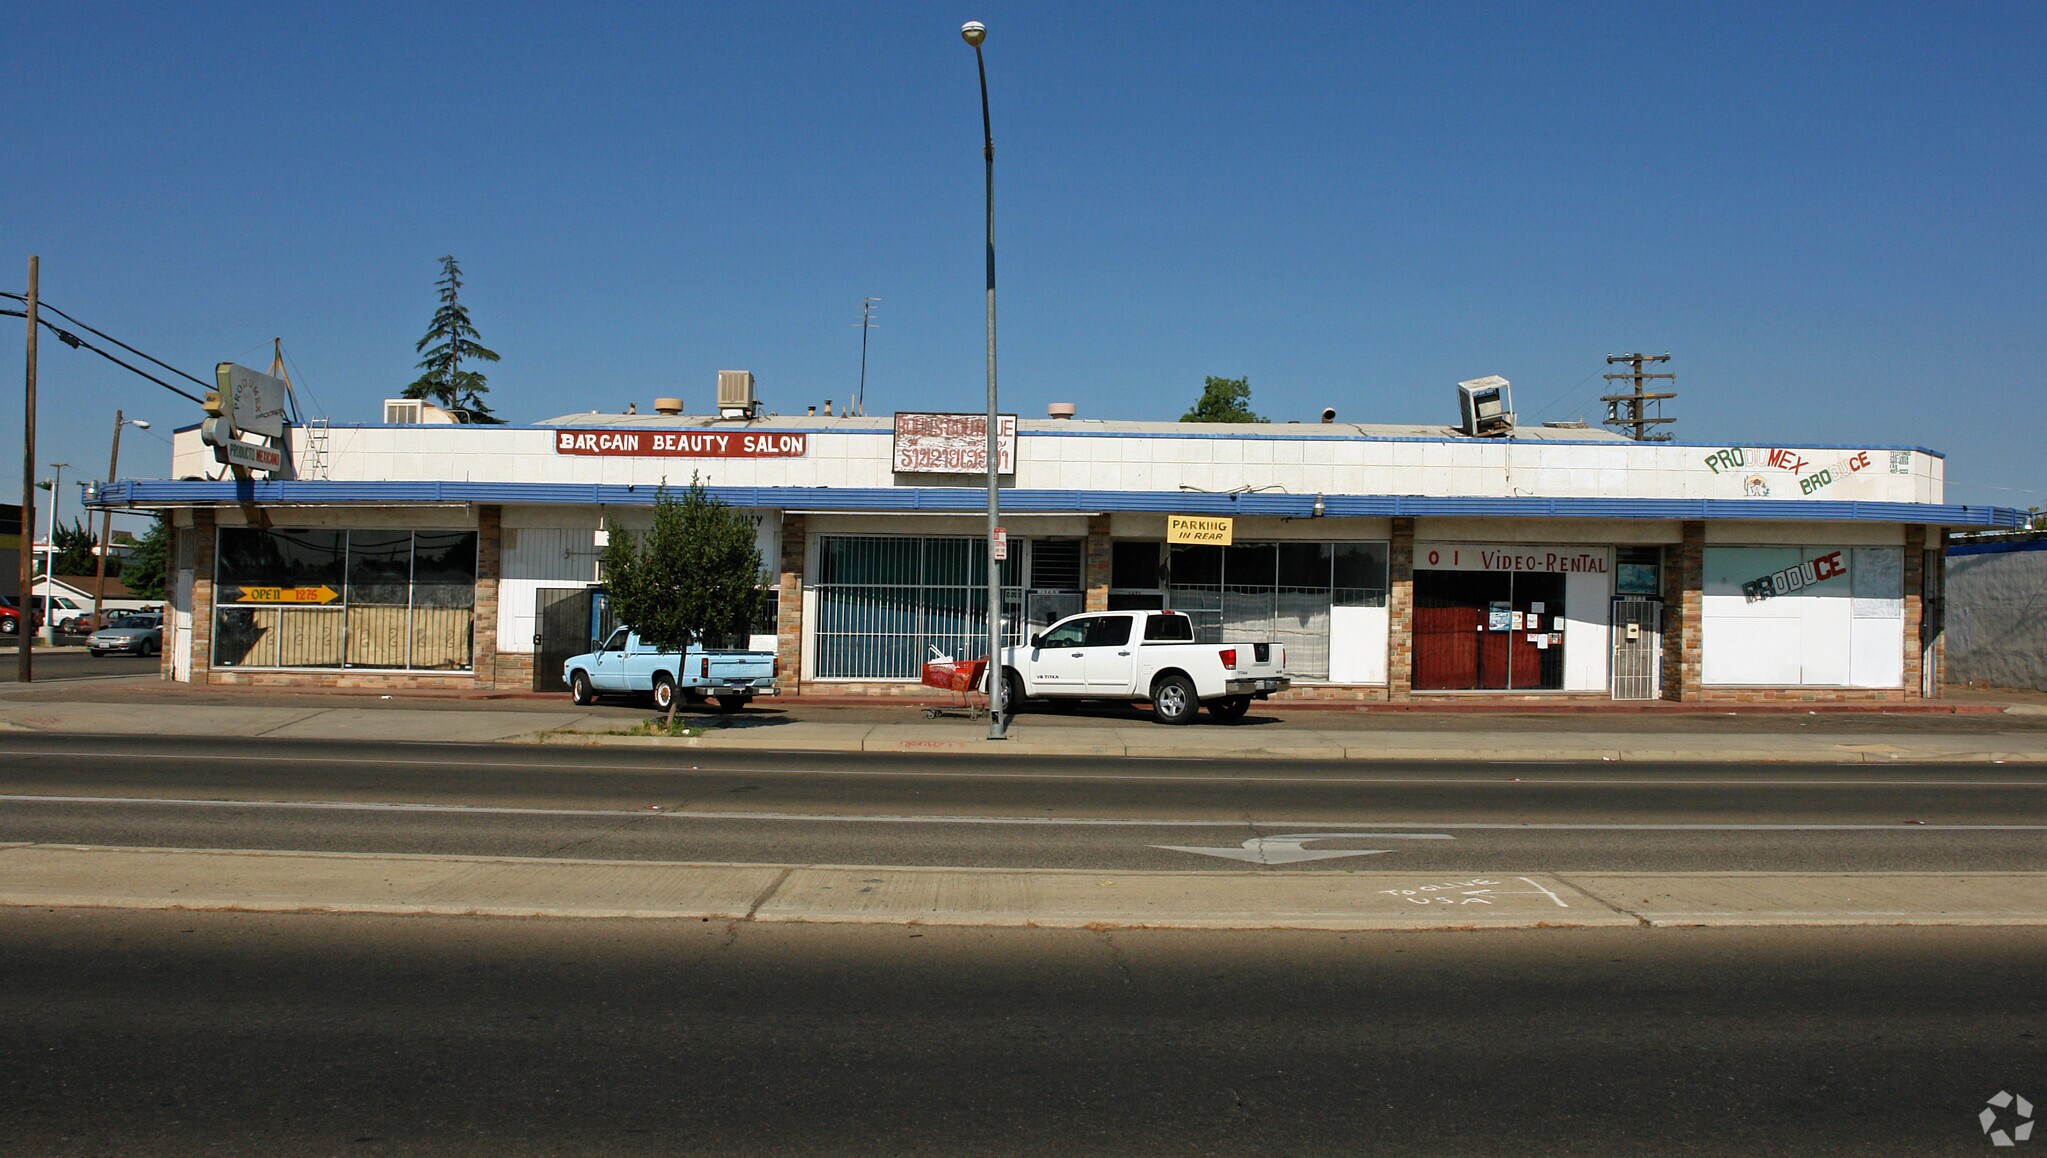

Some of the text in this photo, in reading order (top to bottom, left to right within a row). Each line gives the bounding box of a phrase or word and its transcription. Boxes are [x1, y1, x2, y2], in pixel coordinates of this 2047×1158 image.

[559, 433, 804, 453] BARGAIN BEAUTY SALON
[1704, 447, 1809, 475] PRODUMEX
[1172, 519, 1228, 532] PARKING
[1178, 531, 1224, 542] IN REAR
[1741, 550, 1847, 605] PRODUCE
[294, 589, 319, 601] 1275
